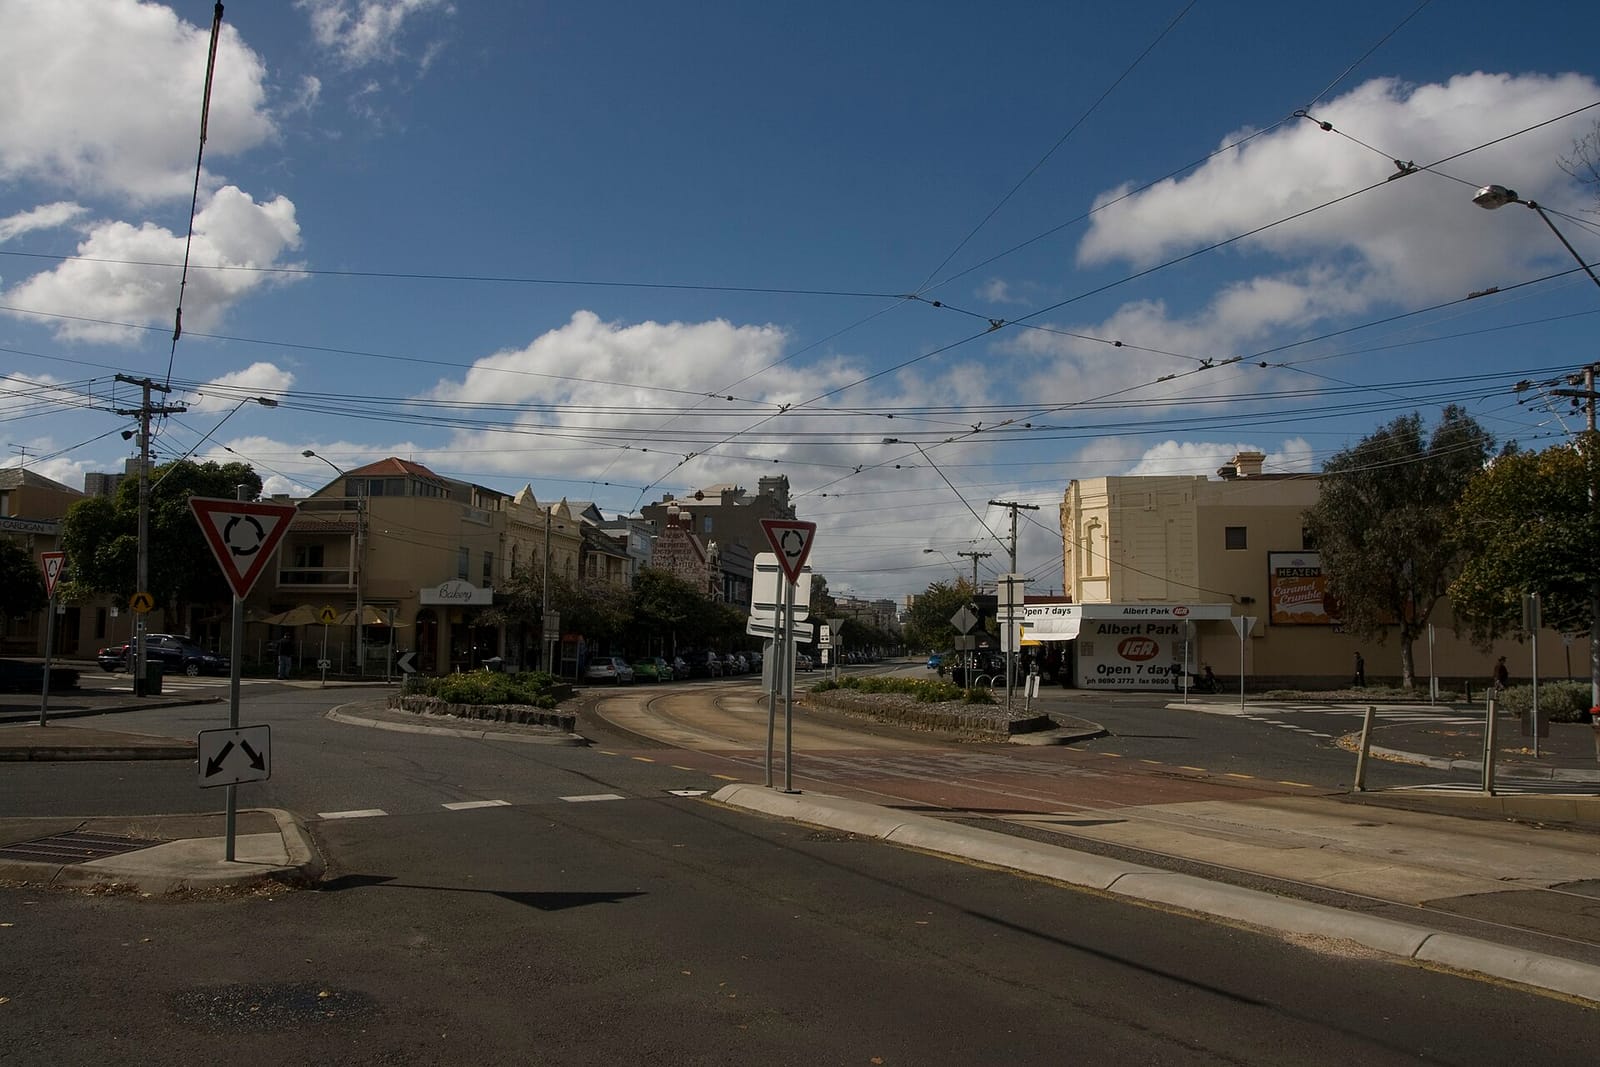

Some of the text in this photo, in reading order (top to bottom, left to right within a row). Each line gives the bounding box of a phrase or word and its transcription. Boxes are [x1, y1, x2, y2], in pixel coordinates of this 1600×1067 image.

[3, 520, 44, 532] CARDIGAN
[1279, 568, 1319, 577] HEAVEN
[438, 583, 472, 602] Bakery
[1273, 580, 1315, 597] Caramel
[1052, 607, 1072, 616] days
[1096, 623, 1179, 634] Albert Park
[1122, 641, 1154, 656] IGA
[1097, 664, 1175, 677] Open 7 day
